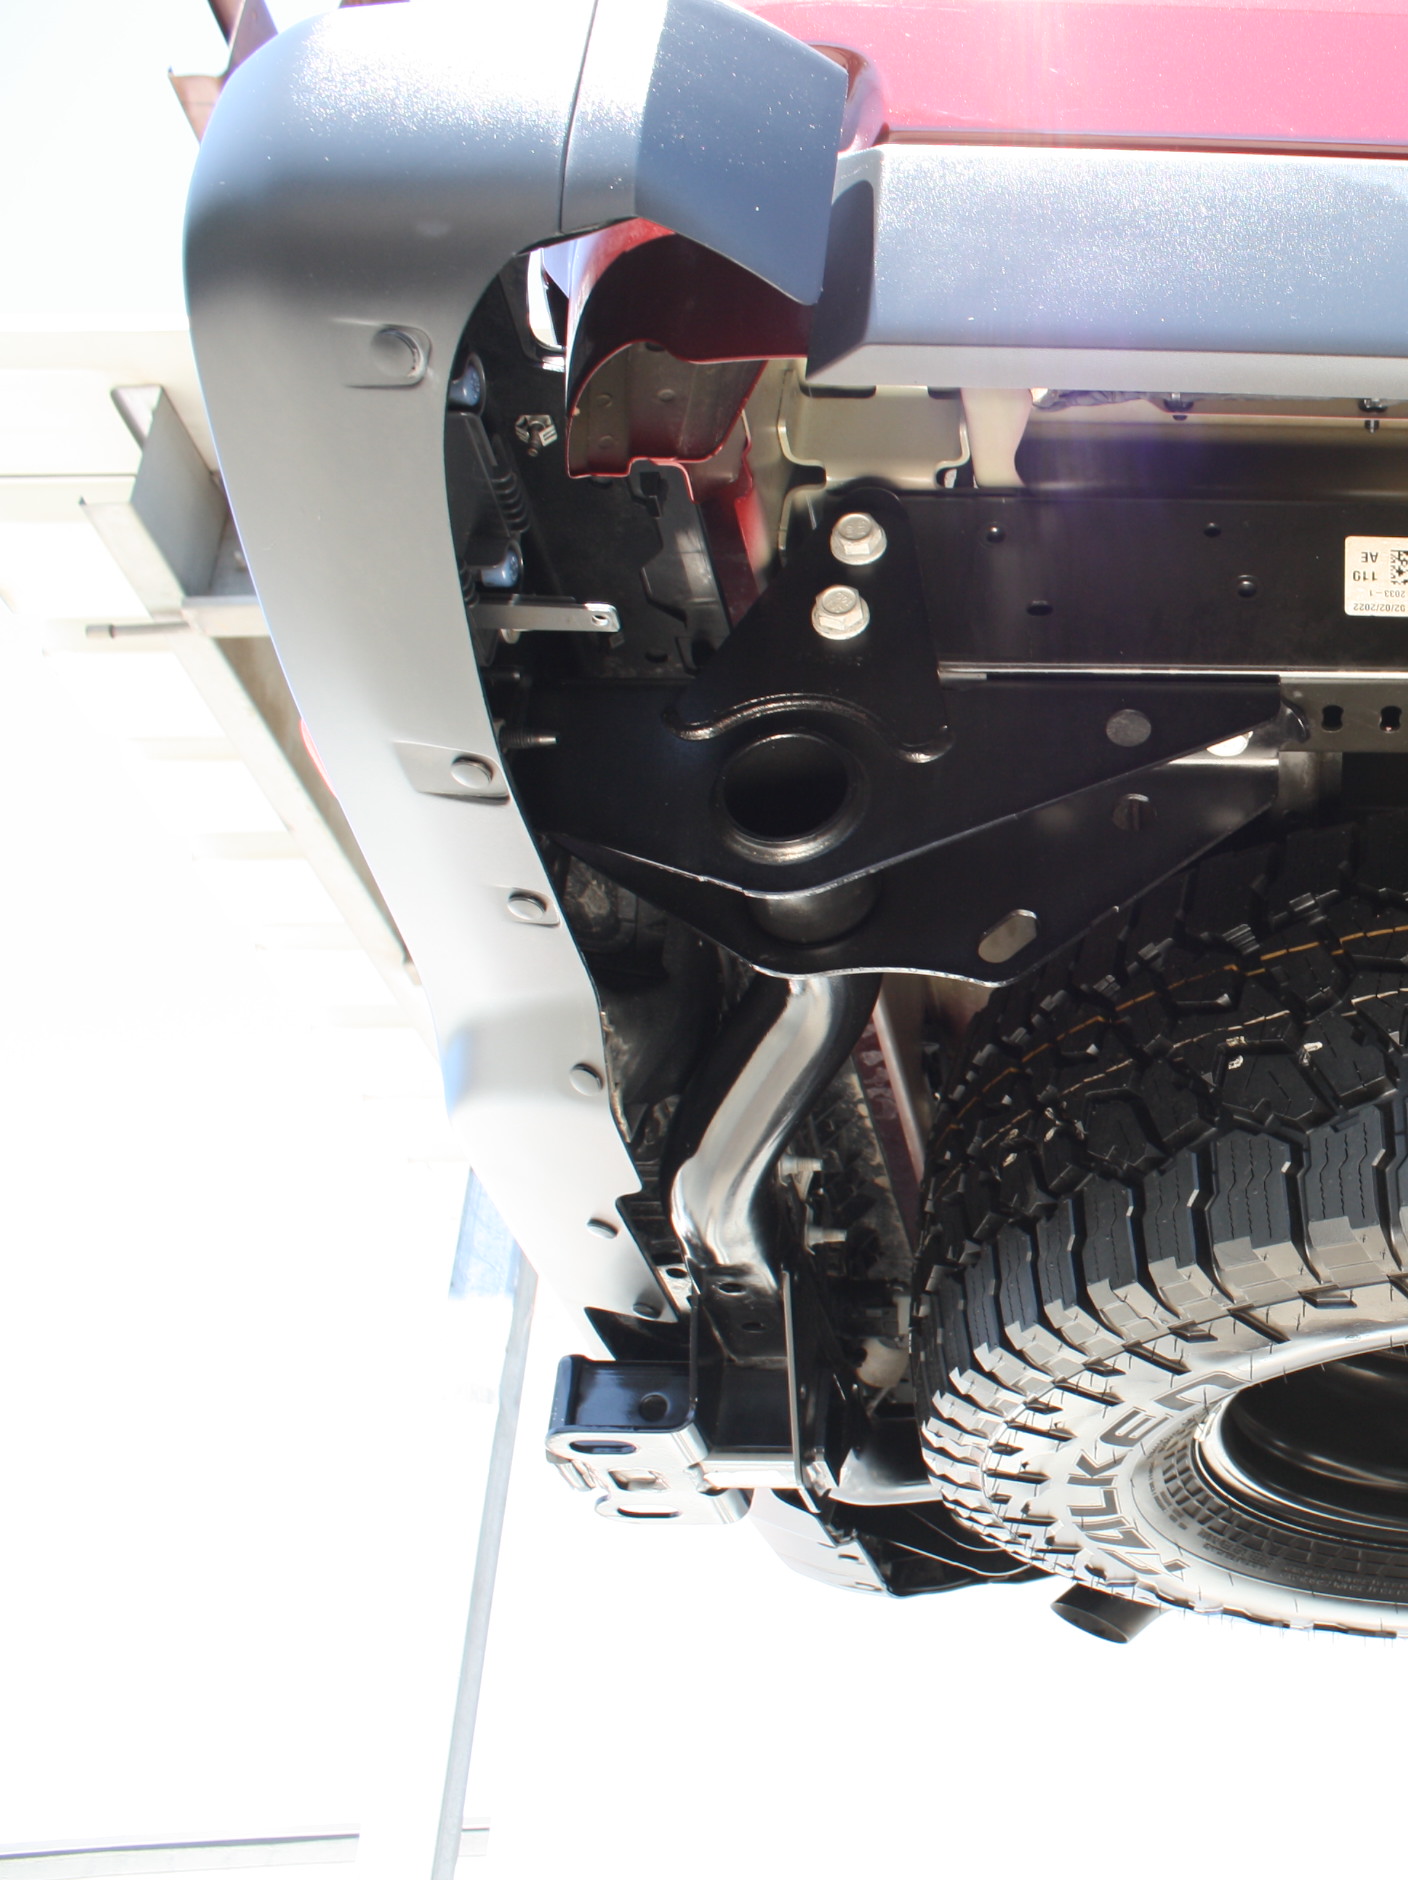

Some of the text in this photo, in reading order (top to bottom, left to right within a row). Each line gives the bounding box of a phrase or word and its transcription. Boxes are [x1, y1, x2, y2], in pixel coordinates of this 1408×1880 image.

[1361, 551, 1379, 563] AE
[1353, 602, 1406, 612] 02/02/2022
[1066, 1371, 1252, 1581] FALKEN
